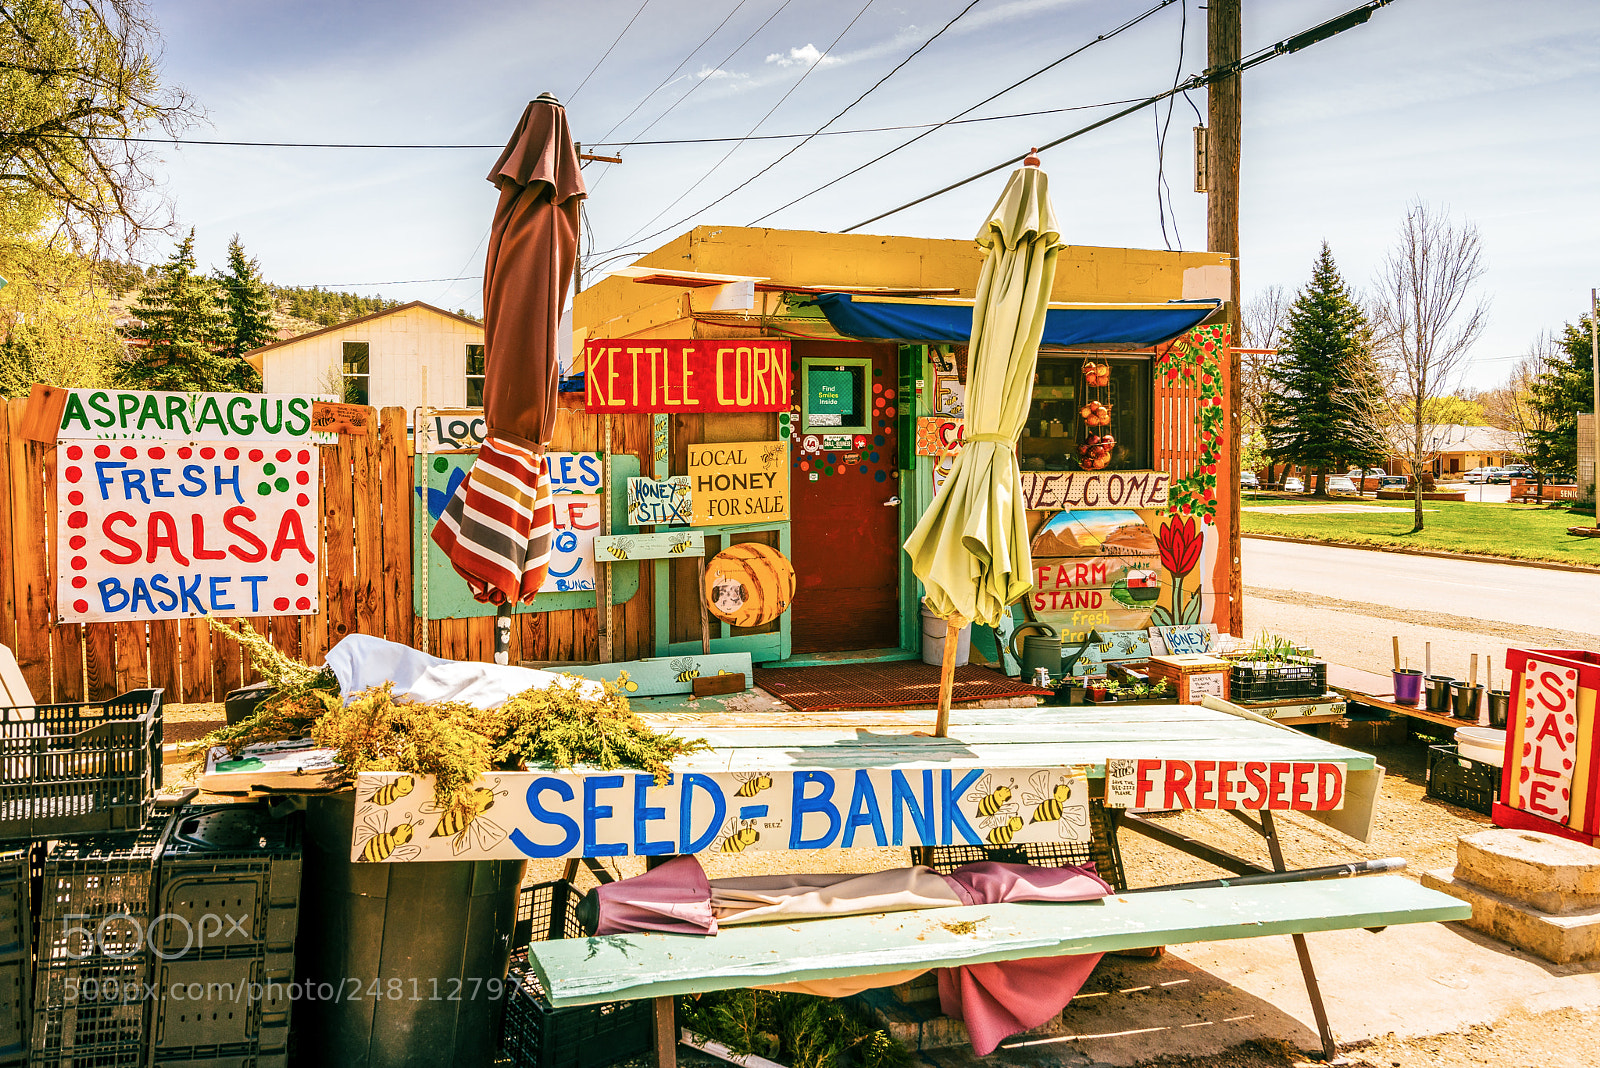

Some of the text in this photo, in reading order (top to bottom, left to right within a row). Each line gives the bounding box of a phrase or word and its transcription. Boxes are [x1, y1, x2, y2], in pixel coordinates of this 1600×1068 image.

[587, 347, 787, 405] KETTLE CORN
[61, 392, 311, 436] ASPARAGUS
[435, 417, 487, 449] LOC
[546, 455, 600, 487] LES
[690, 450, 747, 466] LOCAL
[95, 461, 246, 504] FRESH
[635, 479, 677, 502] HONEY
[698, 472, 777, 492] HONEY
[1021, 473, 1169, 510] WELCOME
[637, 499, 688, 524] STIX
[709, 496, 784, 516] FOR SALE
[100, 506, 315, 567] SALSA
[1038, 563, 1106, 590] FARM
[98, 574, 269, 615] BASKET
[1034, 591, 1103, 611] STAND
[1072, 610, 1110, 626] fresh
[1166, 632, 1204, 648] HONEY
[1530, 671, 1567, 815] SALE
[509, 773, 727, 859] SEED
[789, 769, 985, 849] BANK
